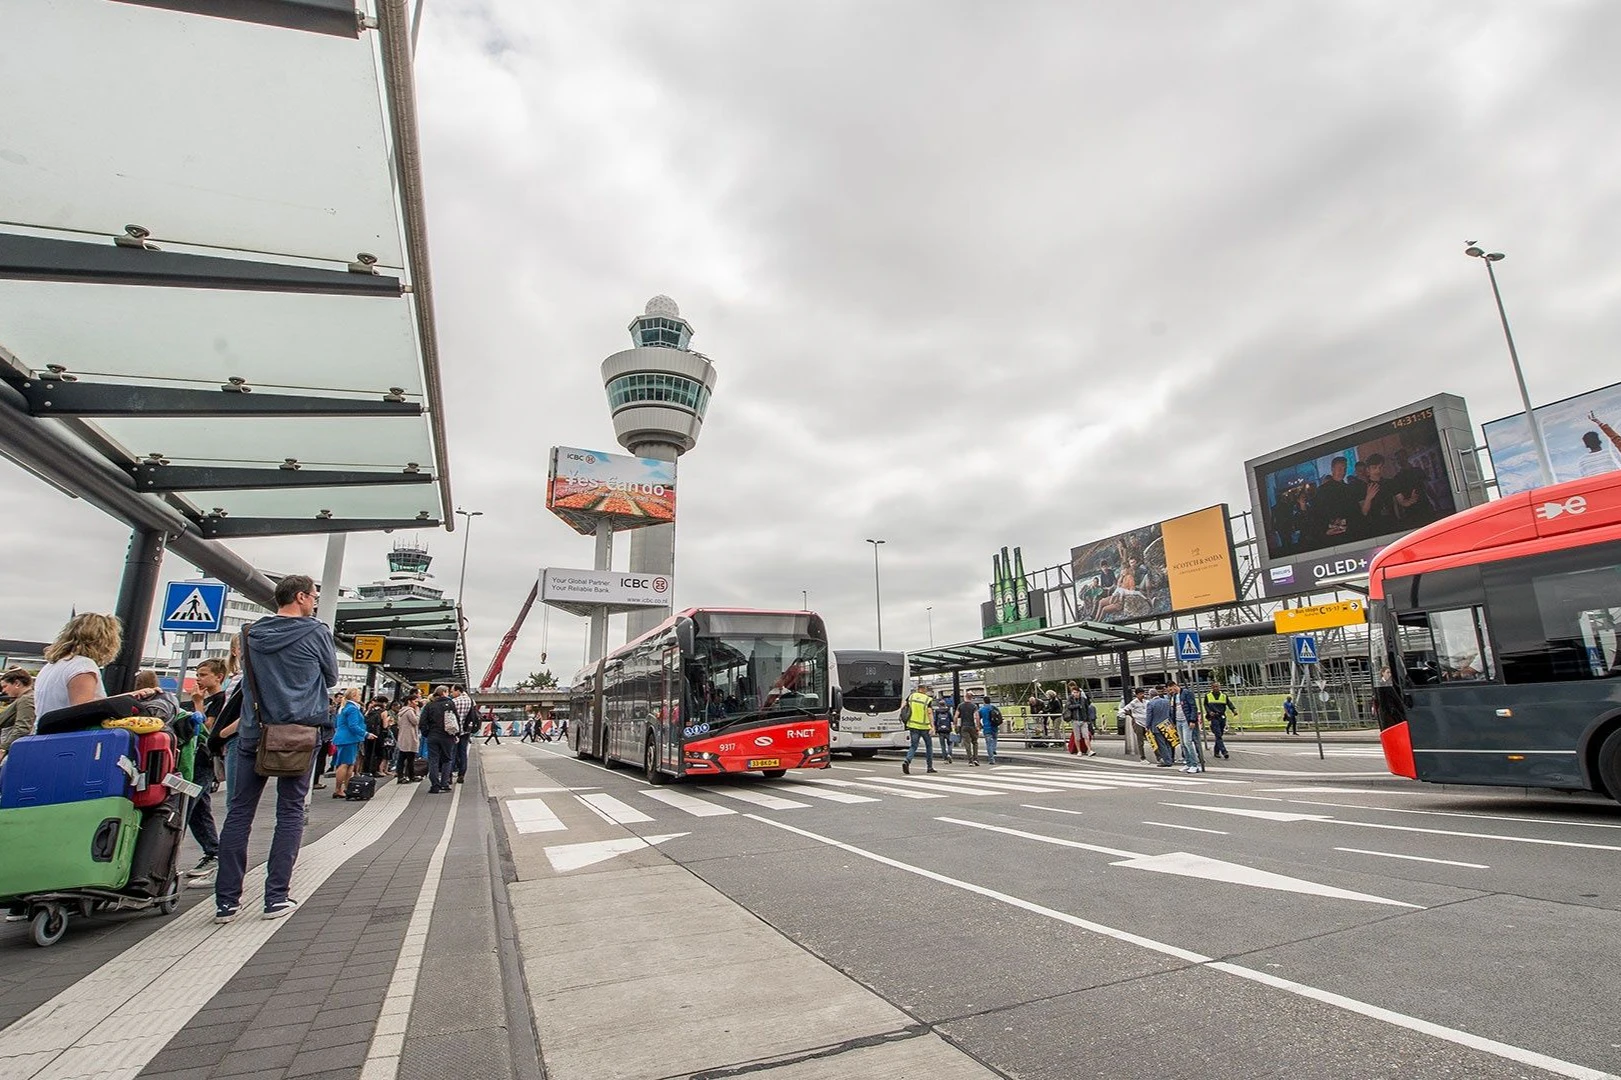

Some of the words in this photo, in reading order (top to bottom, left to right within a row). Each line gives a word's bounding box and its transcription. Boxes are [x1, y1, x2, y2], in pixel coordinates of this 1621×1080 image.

[1391, 410, 1433, 429] 14:31:15
[567, 453, 584, 462] ICBC
[1272, 568, 1291, 577] PHILIPS
[1313, 558, 1368, 578] OLED+
[551, 576, 567, 584] Your
[567, 577, 588, 585] Global
[620, 578, 649, 589] ICBC
[567, 585, 593, 593] Reliable
[355, 648, 374, 660] B7
[719, 742, 736, 752] 9317
